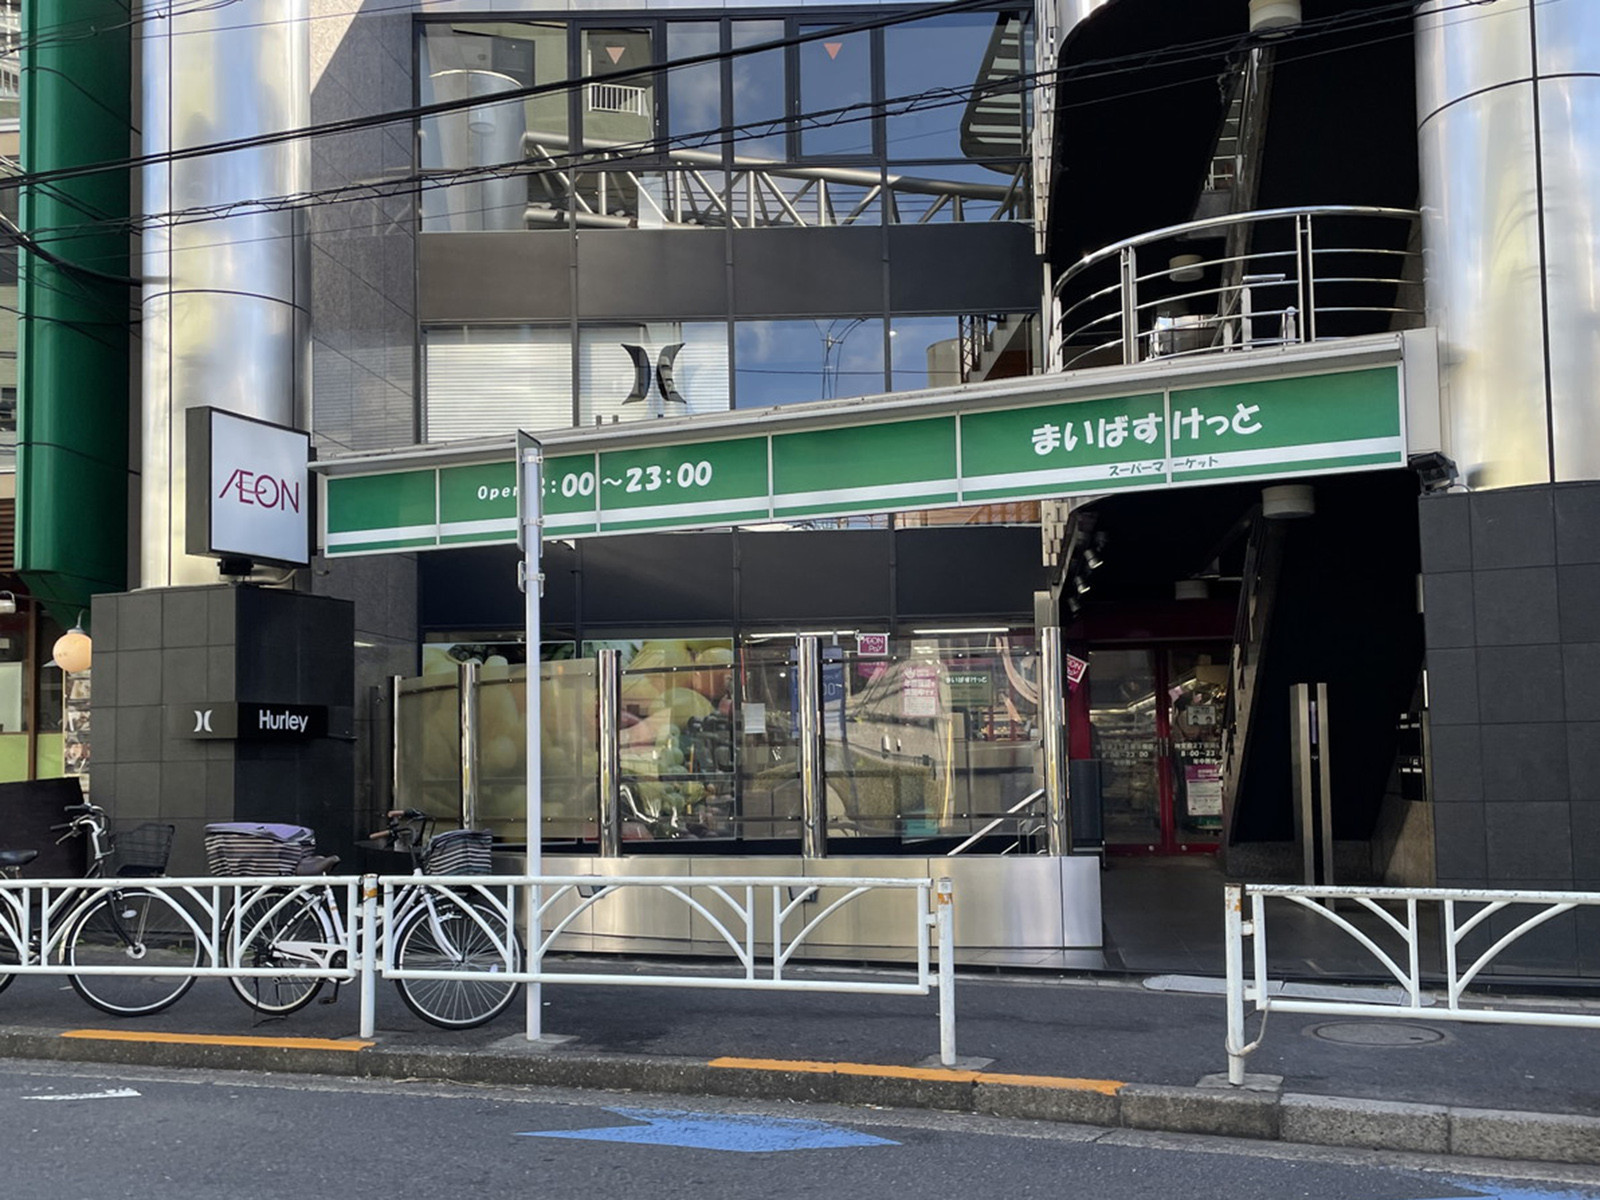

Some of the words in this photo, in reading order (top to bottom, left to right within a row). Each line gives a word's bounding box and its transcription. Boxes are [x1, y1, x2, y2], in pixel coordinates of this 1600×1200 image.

[1031, 403, 1263, 455] まいばすけっと
[541, 461, 712, 498] :00~23:00
[1109, 456, 1218, 477] スーパーマーケット
[259, 709, 308, 733] Hurley
